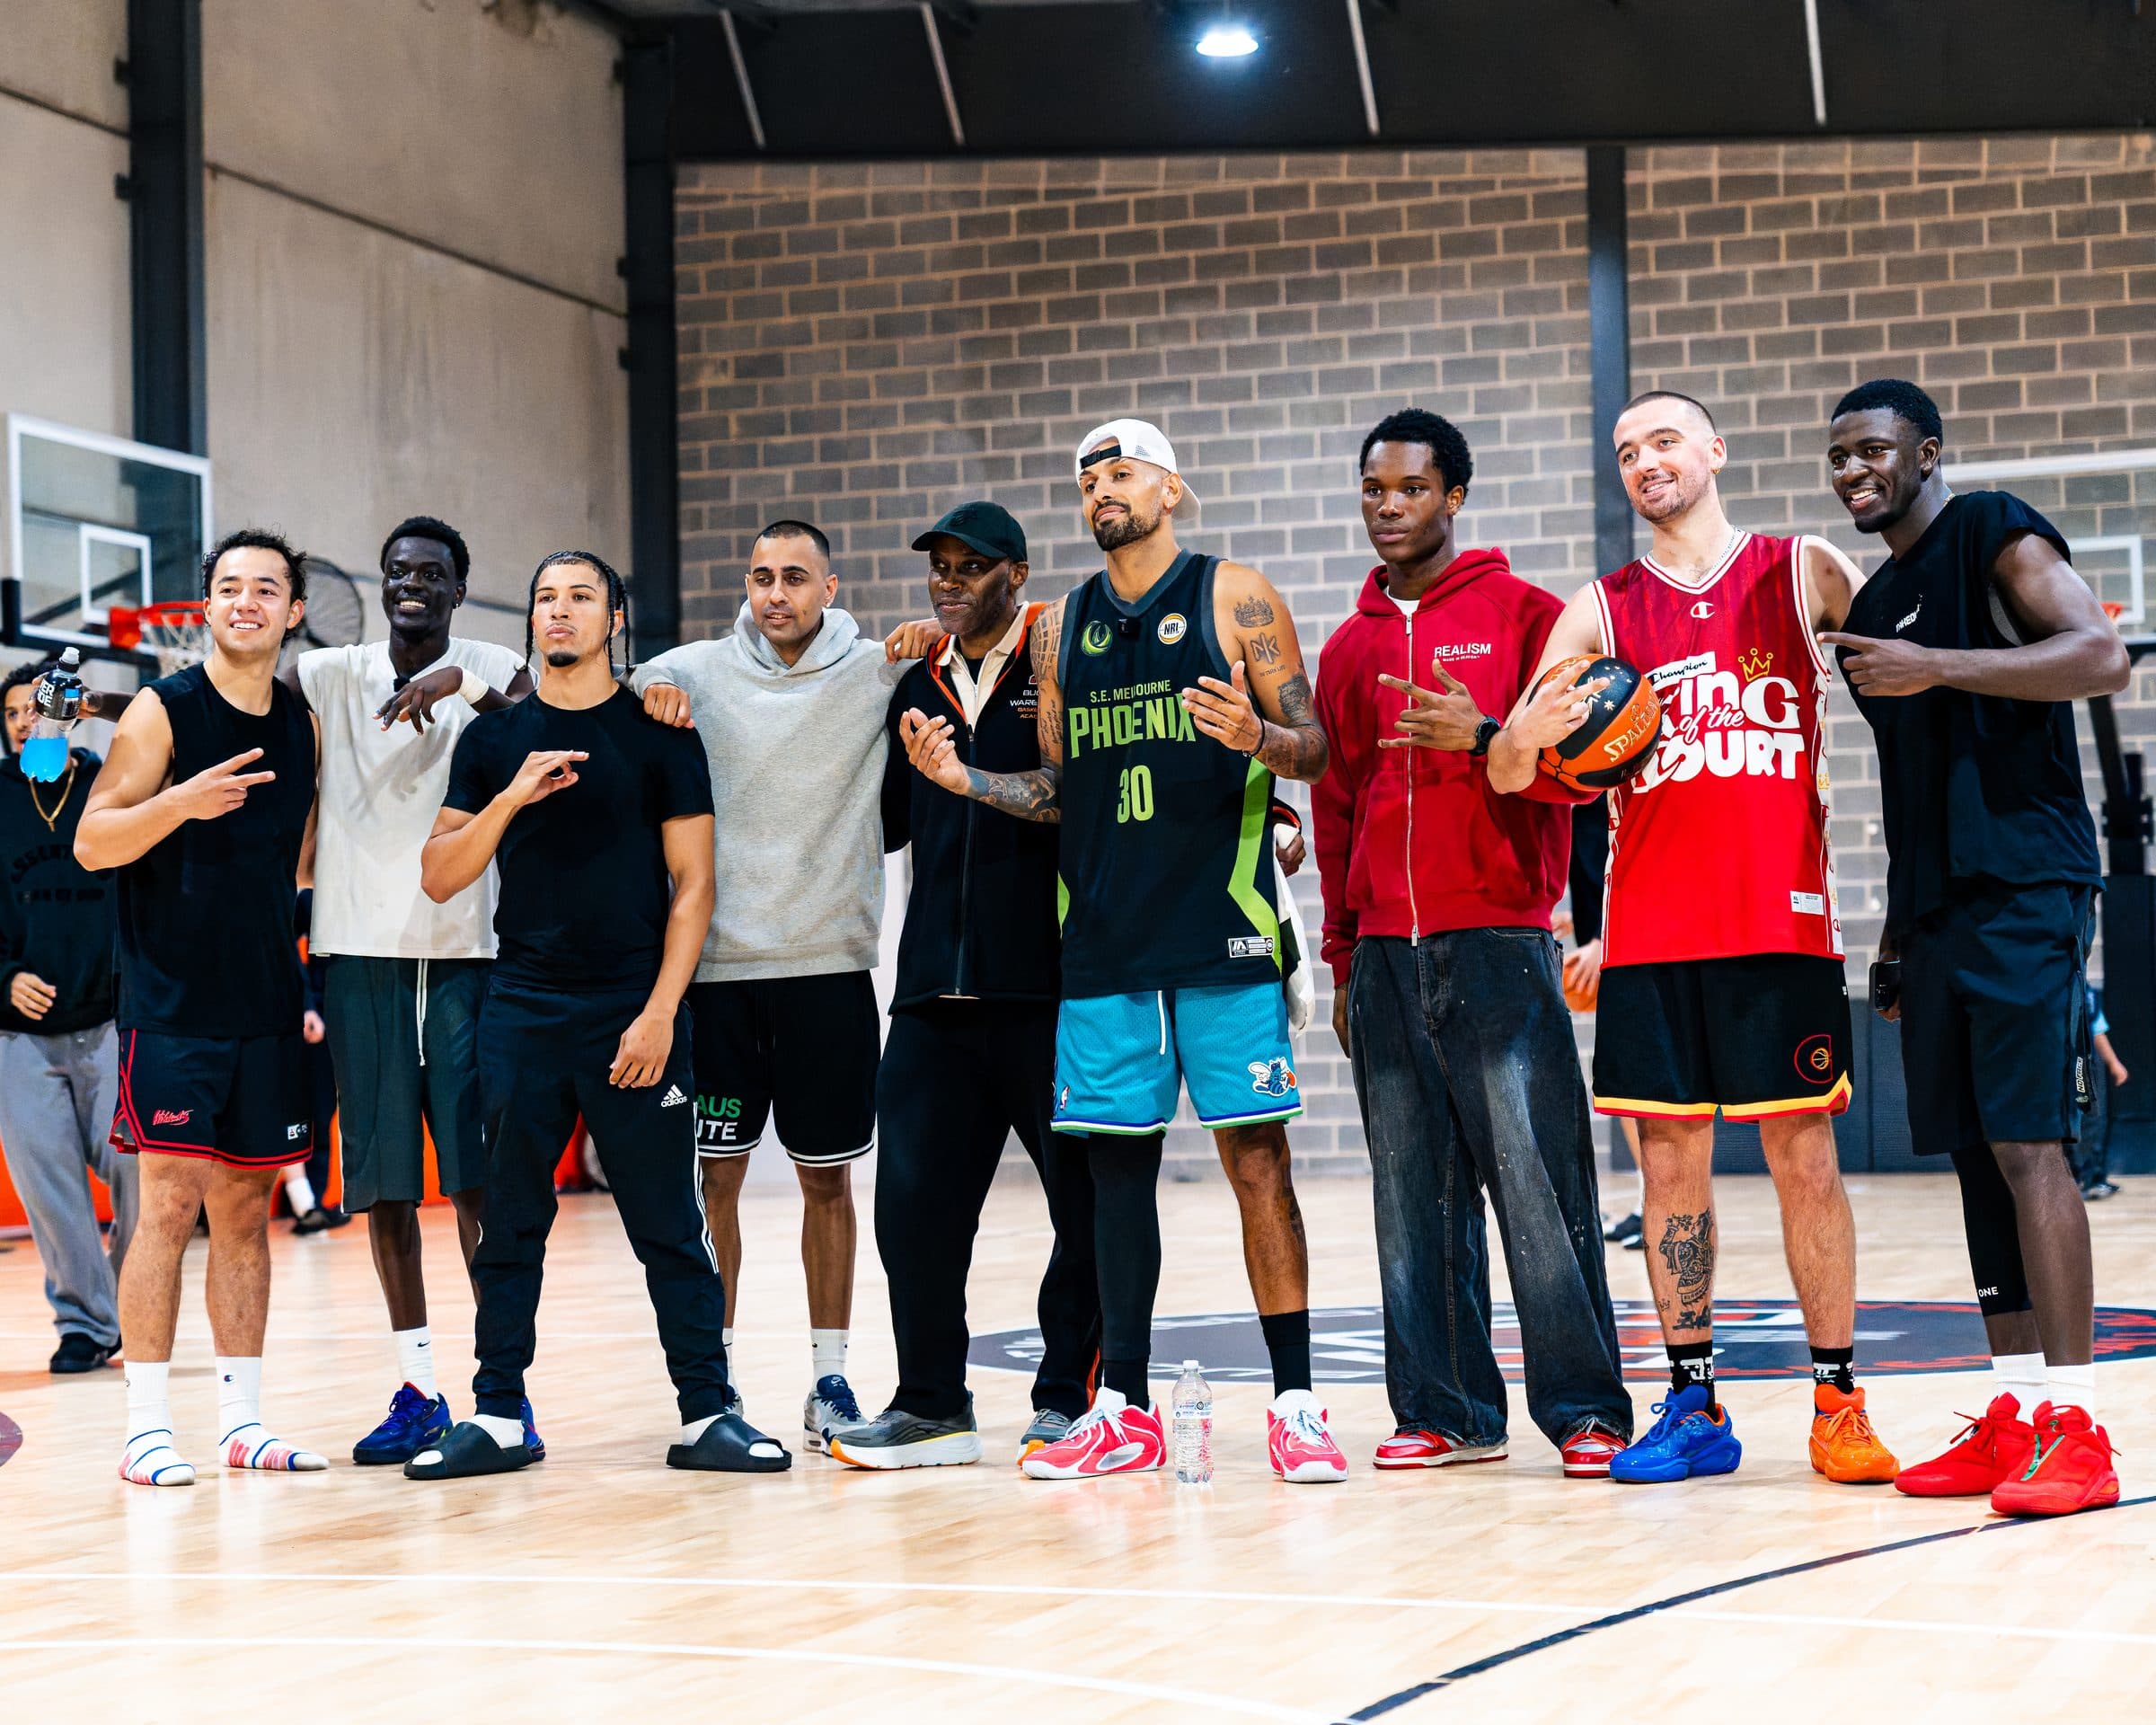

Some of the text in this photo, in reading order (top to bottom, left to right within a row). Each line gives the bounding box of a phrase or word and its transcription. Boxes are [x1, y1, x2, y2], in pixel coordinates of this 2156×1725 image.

[1434, 642, 1492, 658] REALISM
[1650, 659, 1708, 684] Champion
[1090, 679, 1172, 703] S.E. MELOURNE
[1067, 692, 1197, 759] PHOENIX
[1678, 703, 1745, 745] of the
[1630, 730, 1805, 794] COURT
[1117, 765, 1154, 824] 30
[660, 1095, 688, 1108] adidas
[696, 1119, 738, 1141] ITE
[1978, 1286, 1999, 1297] ONE
